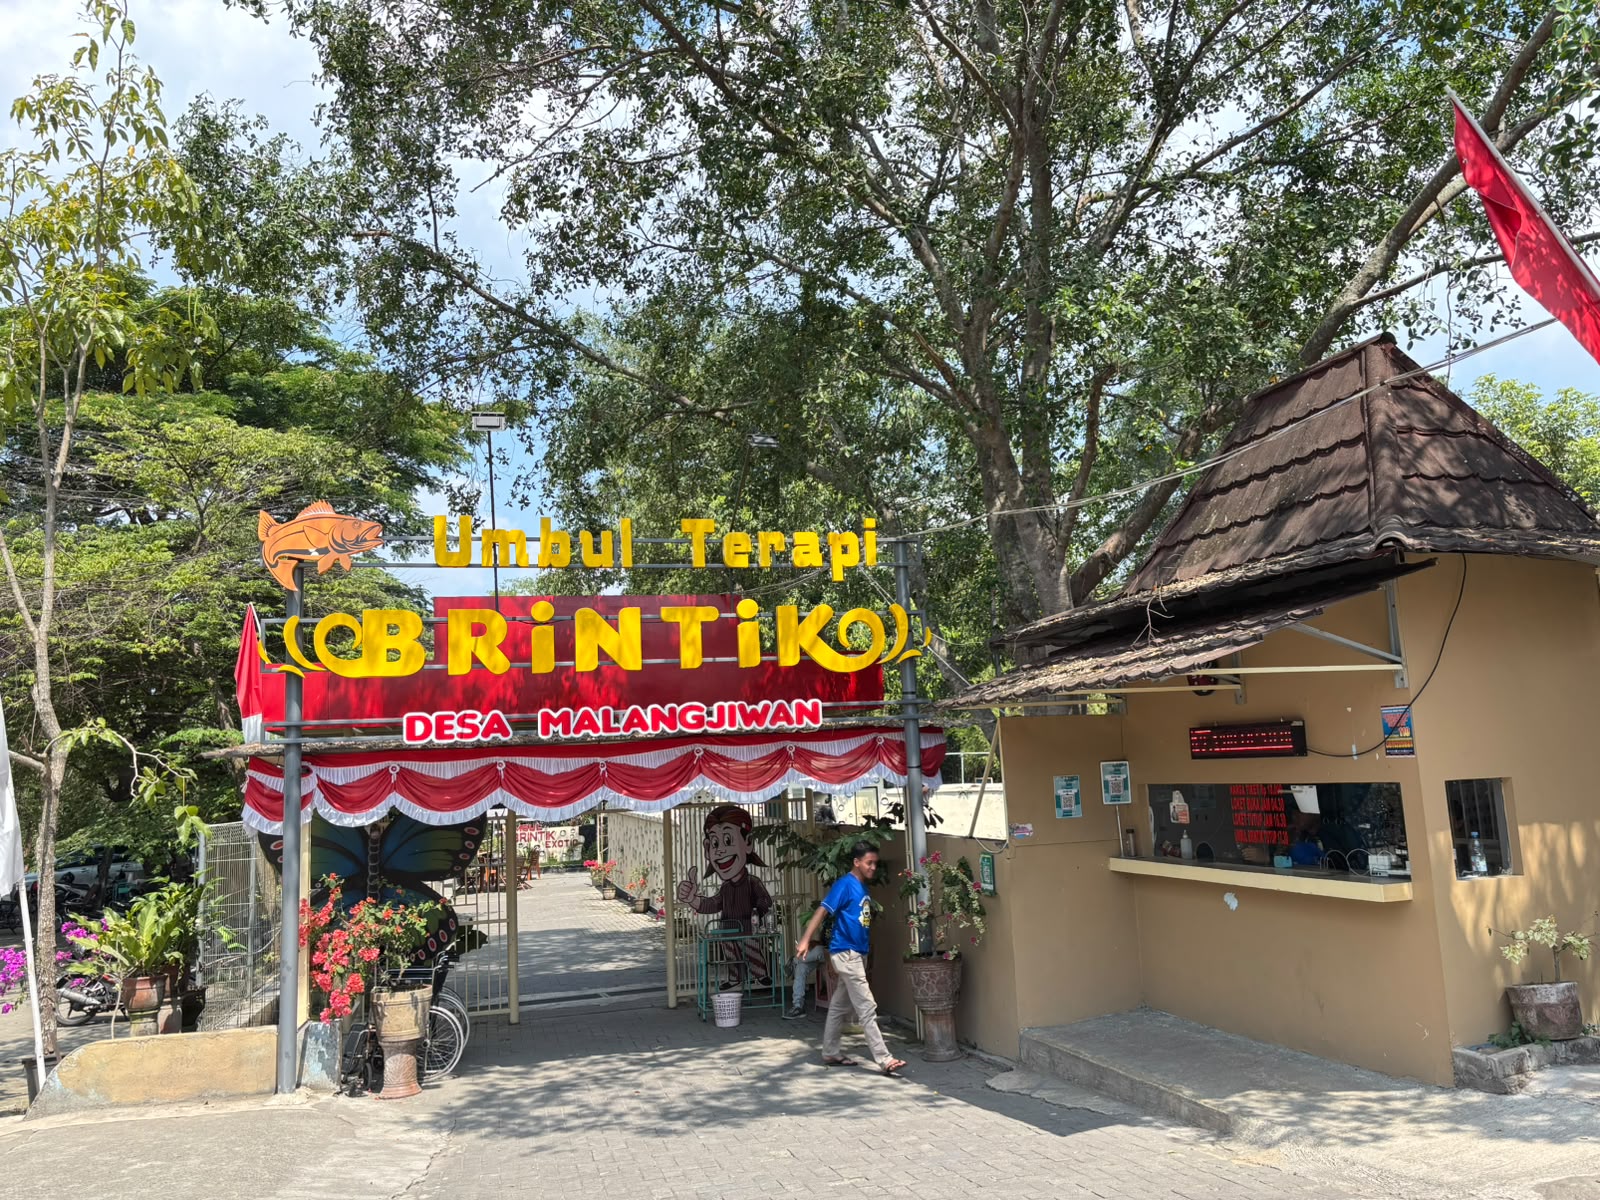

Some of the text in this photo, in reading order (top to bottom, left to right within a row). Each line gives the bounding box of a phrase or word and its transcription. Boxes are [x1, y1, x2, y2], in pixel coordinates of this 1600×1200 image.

[433, 514, 878, 582] Umbul Terapi
[403, 698, 823, 744] DESA MALANGJIWAN
